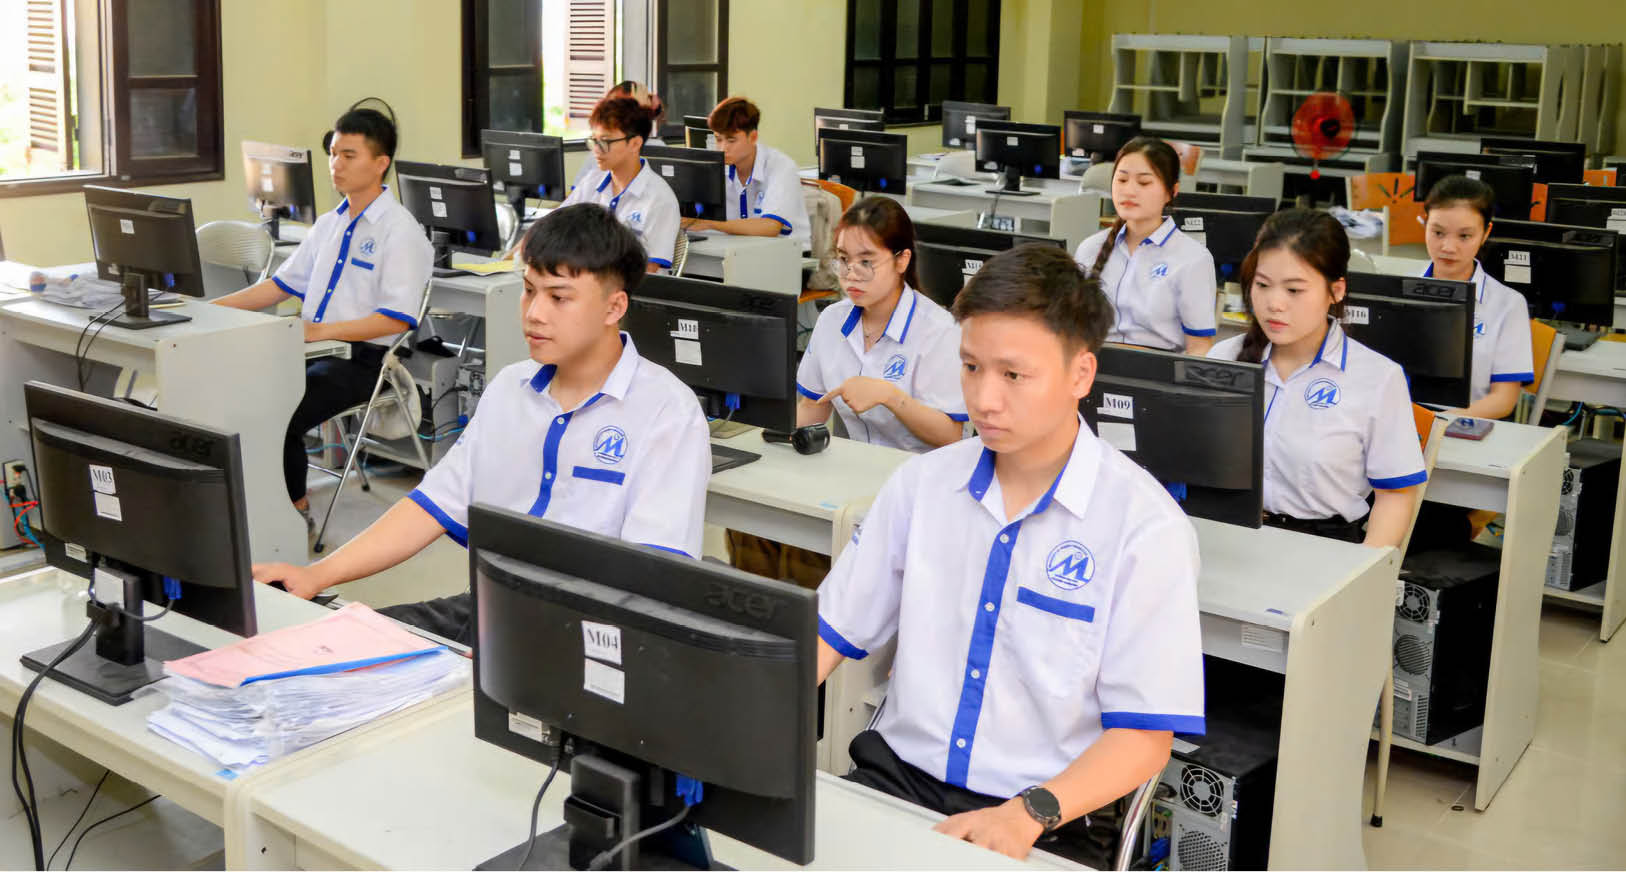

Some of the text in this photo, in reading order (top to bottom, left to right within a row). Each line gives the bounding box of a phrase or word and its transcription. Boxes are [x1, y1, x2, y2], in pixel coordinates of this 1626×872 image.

[1104, 397, 1130, 410] M09
[92, 469, 113, 483] M03
[706, 586, 787, 620] acer
[587, 629, 619, 650] M04
